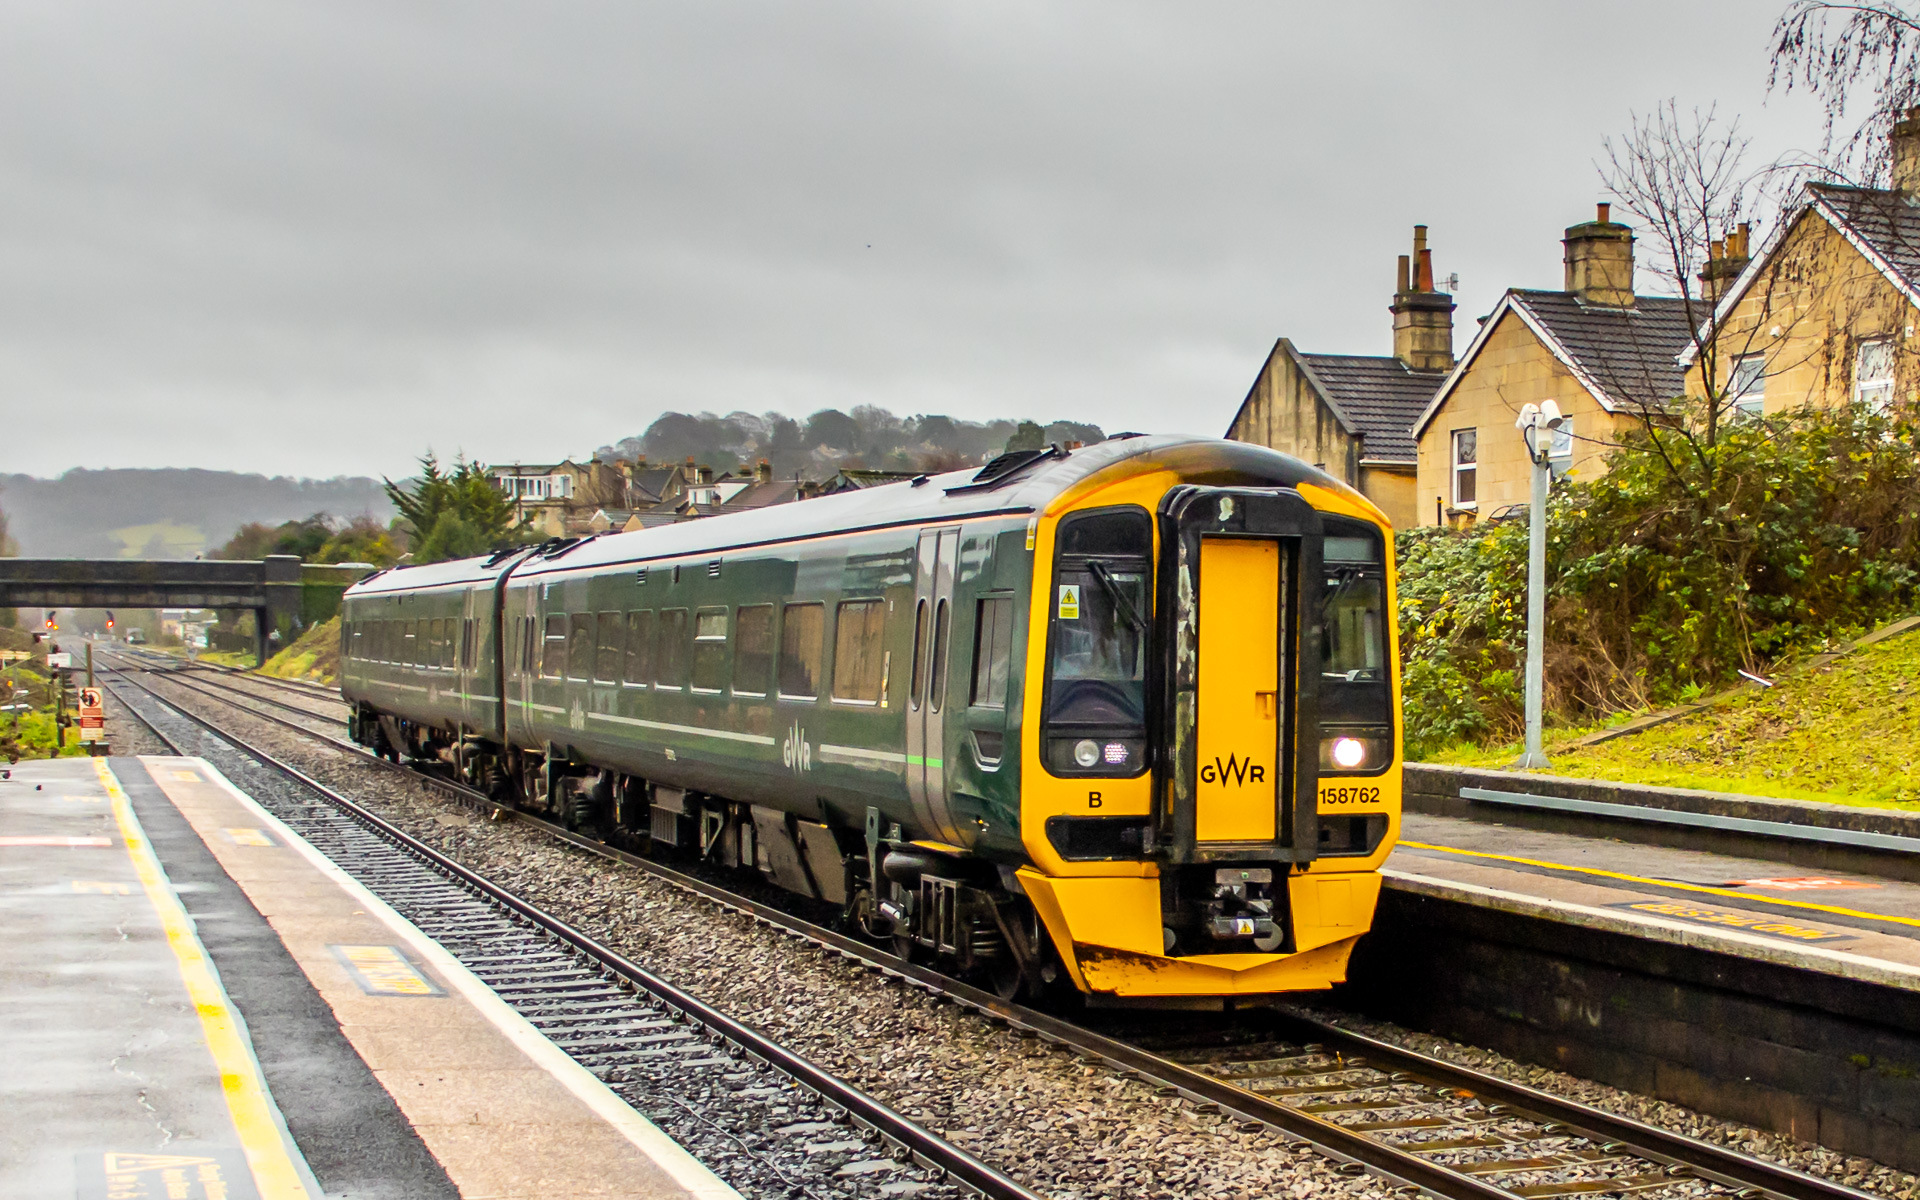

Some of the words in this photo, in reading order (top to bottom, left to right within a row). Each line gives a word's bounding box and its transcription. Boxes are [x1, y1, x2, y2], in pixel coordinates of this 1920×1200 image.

[783, 718, 811, 774] GWR
[1200, 751, 1265, 789] GWR
[1088, 791, 1103, 809] B
[1319, 786, 1380, 804] 158762
